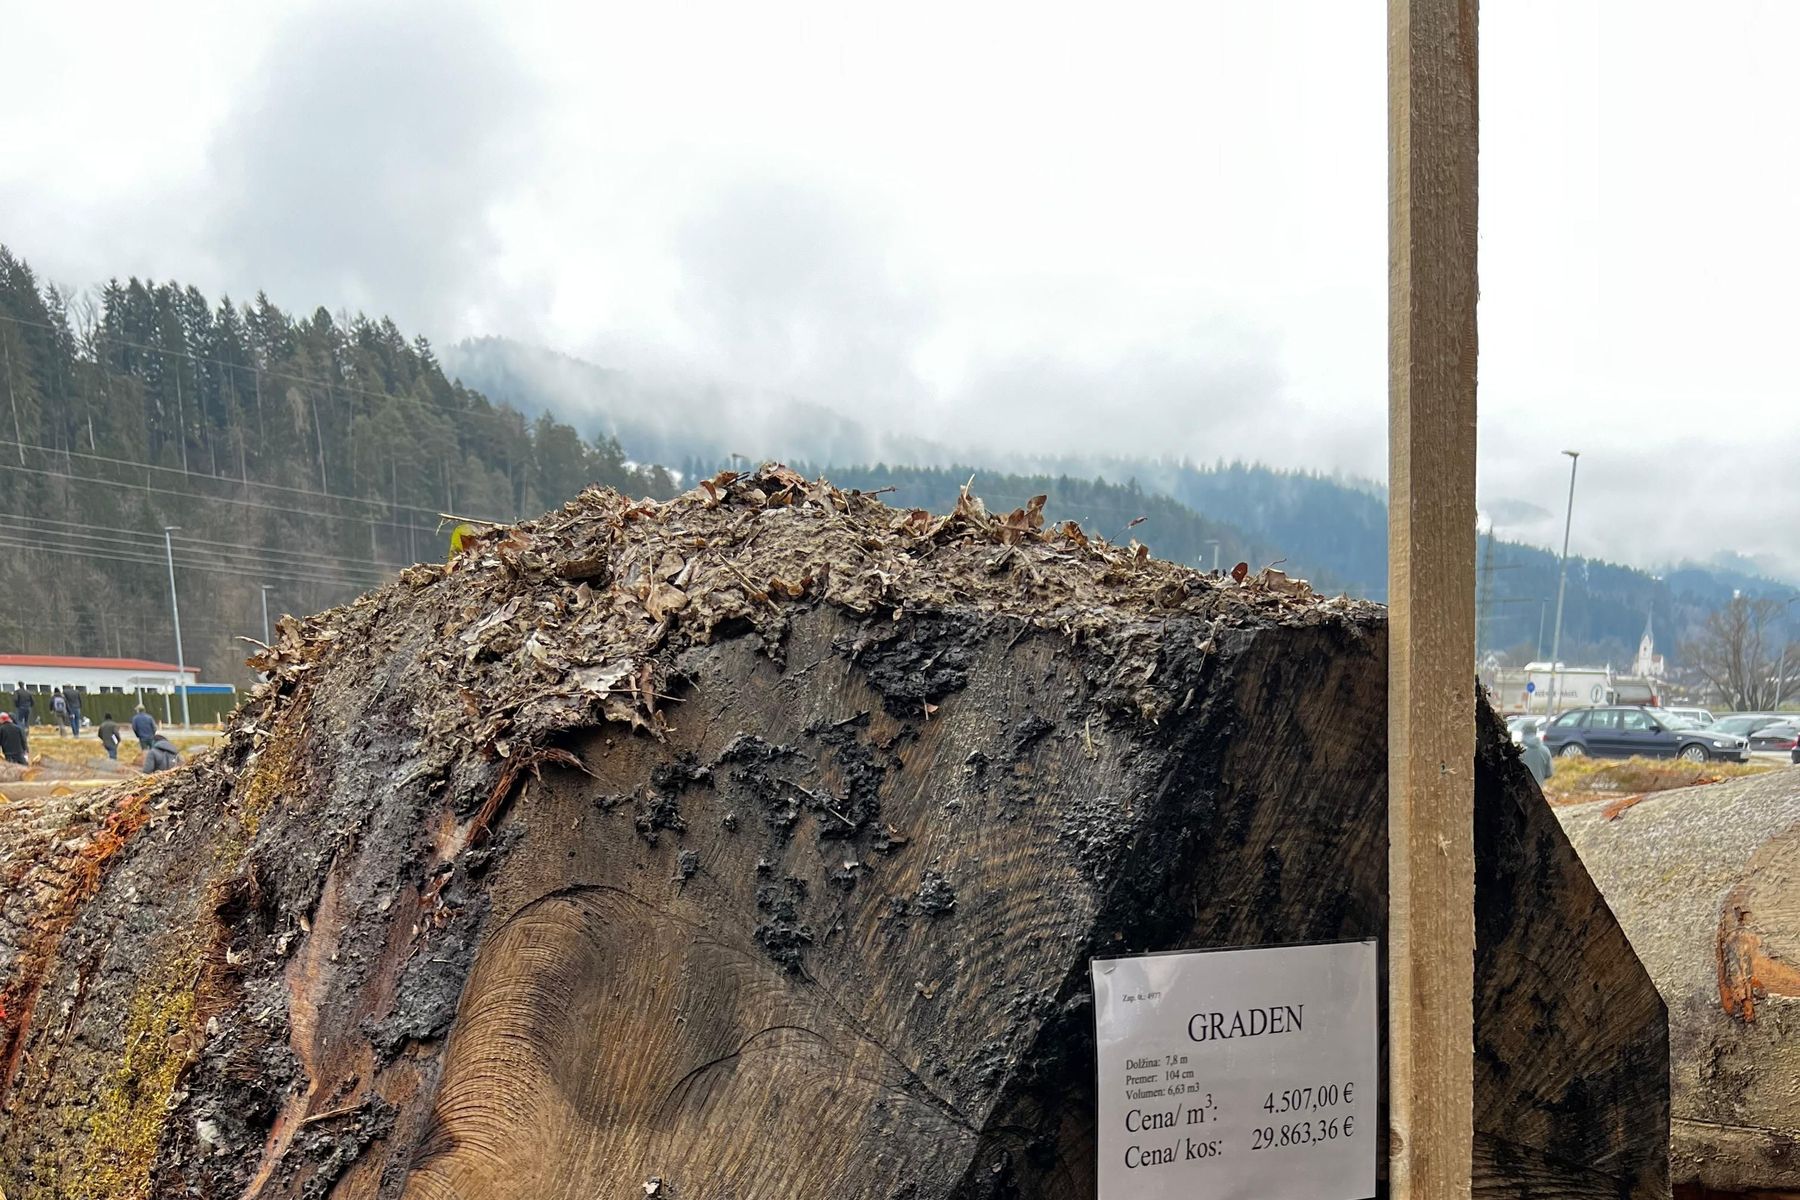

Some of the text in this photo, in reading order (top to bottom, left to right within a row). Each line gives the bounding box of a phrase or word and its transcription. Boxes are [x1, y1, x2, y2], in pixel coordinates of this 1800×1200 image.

[1188, 1004, 1304, 1042] GRADEN
[1126, 1055, 1188, 1070] Dolžina: 7,8 m
[1126, 1069, 1195, 1086] Premer: 104 cm
[1126, 1082, 1200, 1100] Volumen: 6,63 m3
[1125, 1103, 1182, 1133] Cena/
[1263, 1084, 1339, 1114] 4.507,00
[1343, 1082, 1354, 1104] €
[1124, 1115, 1354, 1169] Cena/ kos: 29.863,36 €
